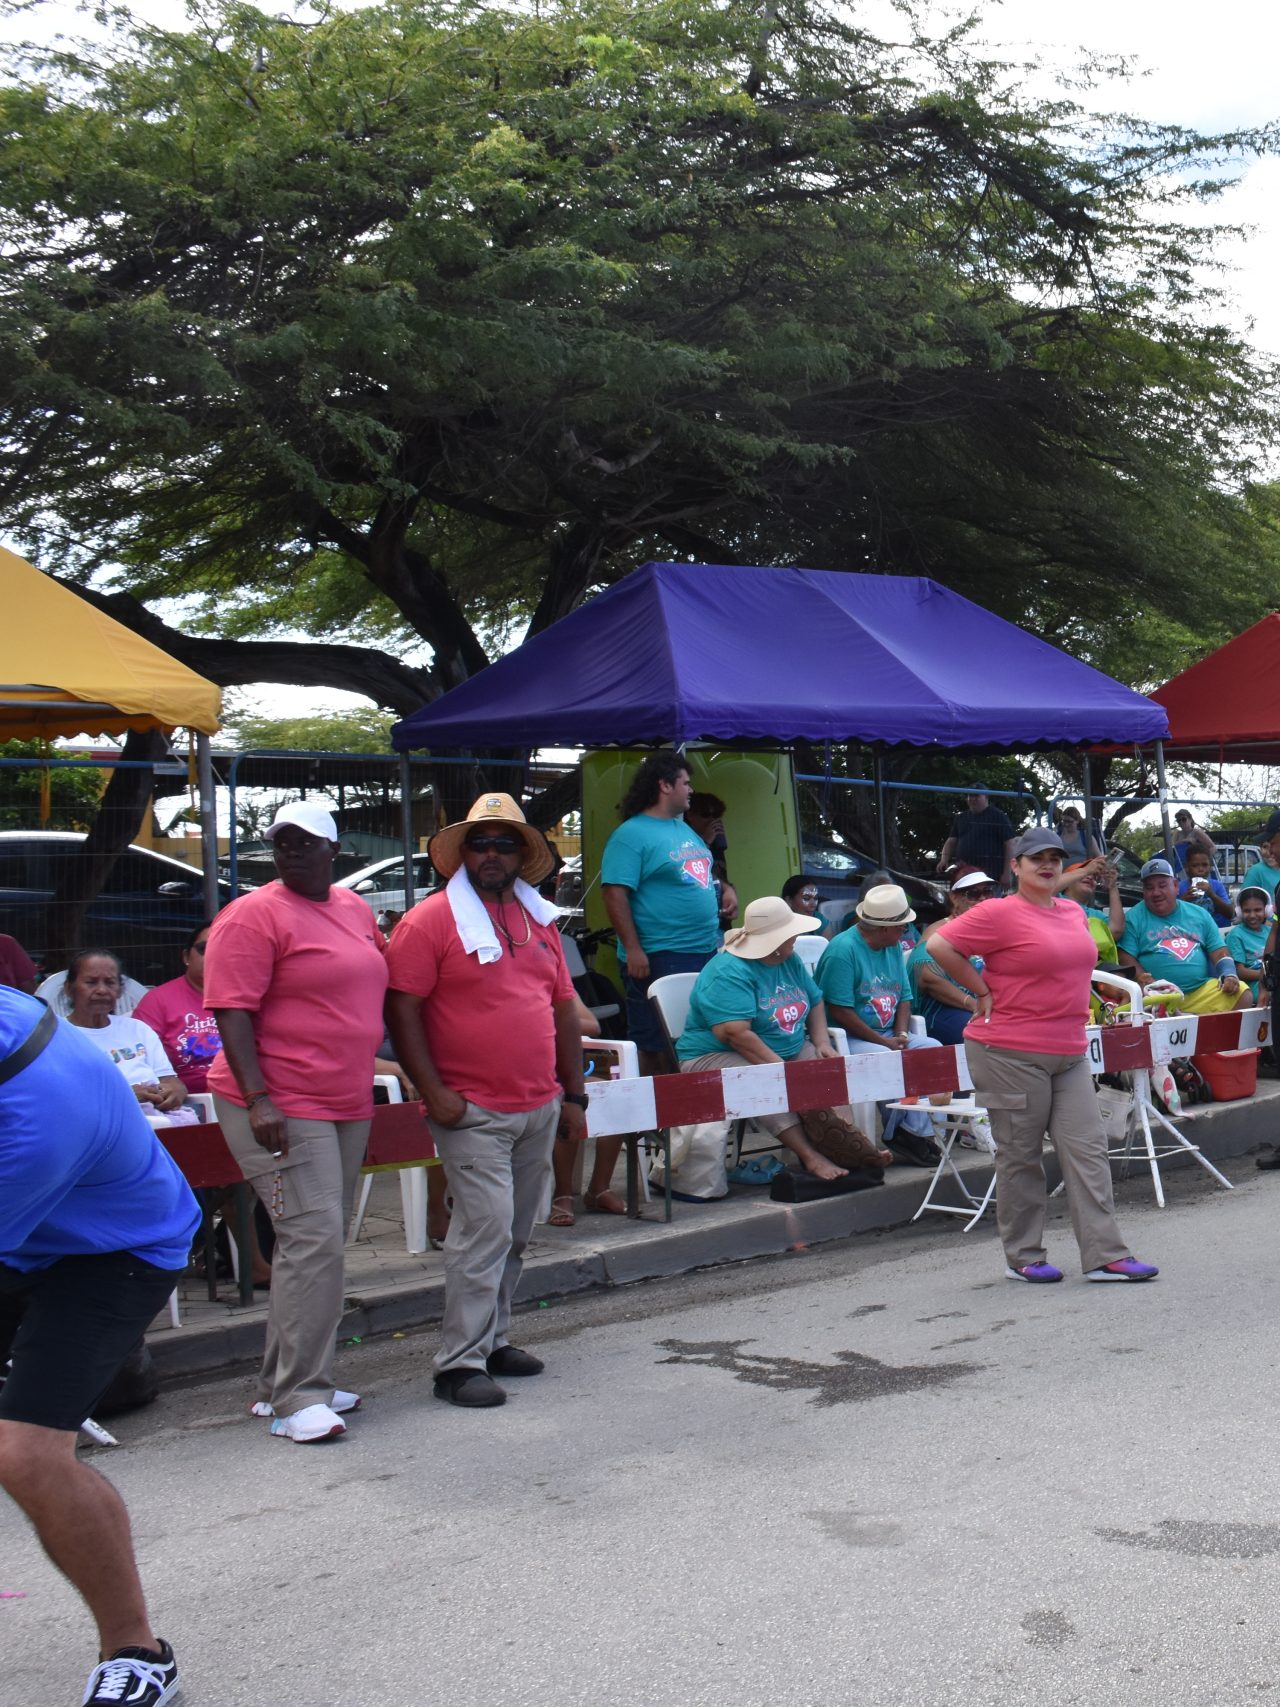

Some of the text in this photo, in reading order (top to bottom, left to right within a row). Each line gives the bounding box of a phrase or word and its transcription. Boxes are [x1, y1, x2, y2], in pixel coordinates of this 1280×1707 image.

[691, 860, 705, 875] 69
[1171, 937, 1189, 949] 69
[879, 996, 892, 1012] 69
[184, 1012, 218, 1029] Citiz
[783, 1005, 798, 1023] 69
